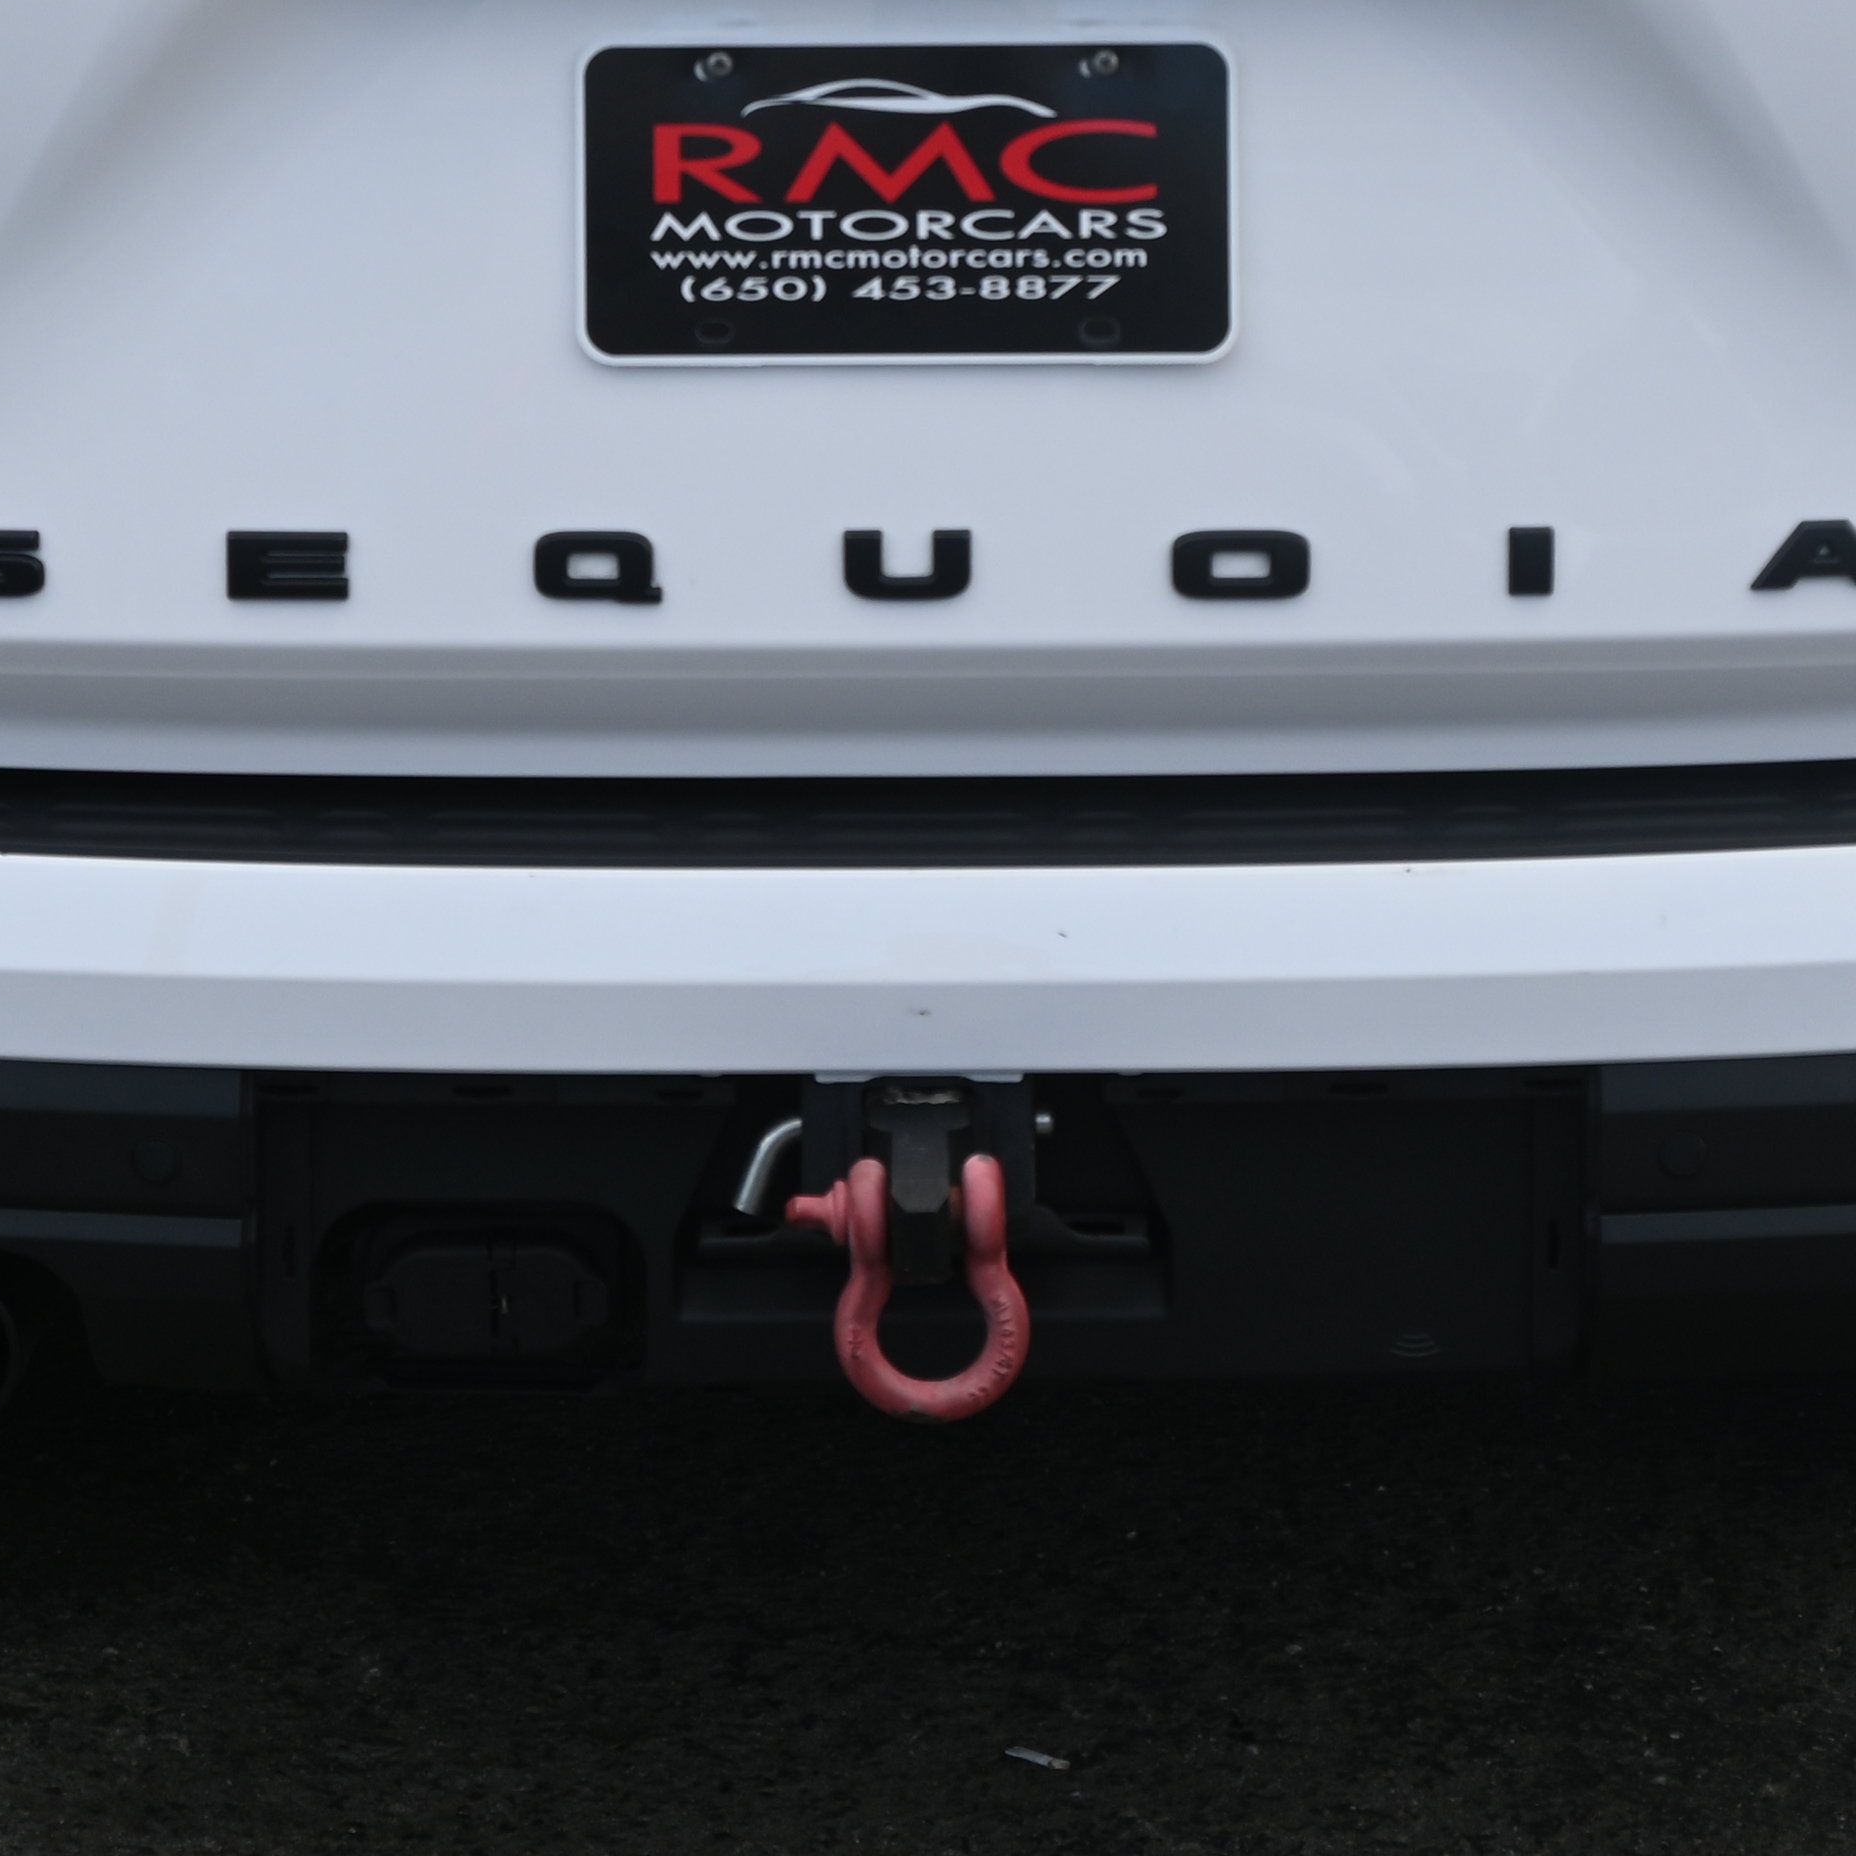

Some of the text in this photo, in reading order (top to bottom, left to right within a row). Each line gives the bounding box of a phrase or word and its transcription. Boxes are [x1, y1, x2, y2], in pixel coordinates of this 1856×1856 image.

[653, 119, 1159, 204] RMC
[651, 208, 1168, 242] MOTORCARS
[650, 245, 1148, 270] www.rmcmotorcars.com
[680, 274, 1121, 303] (650) 453-8877
